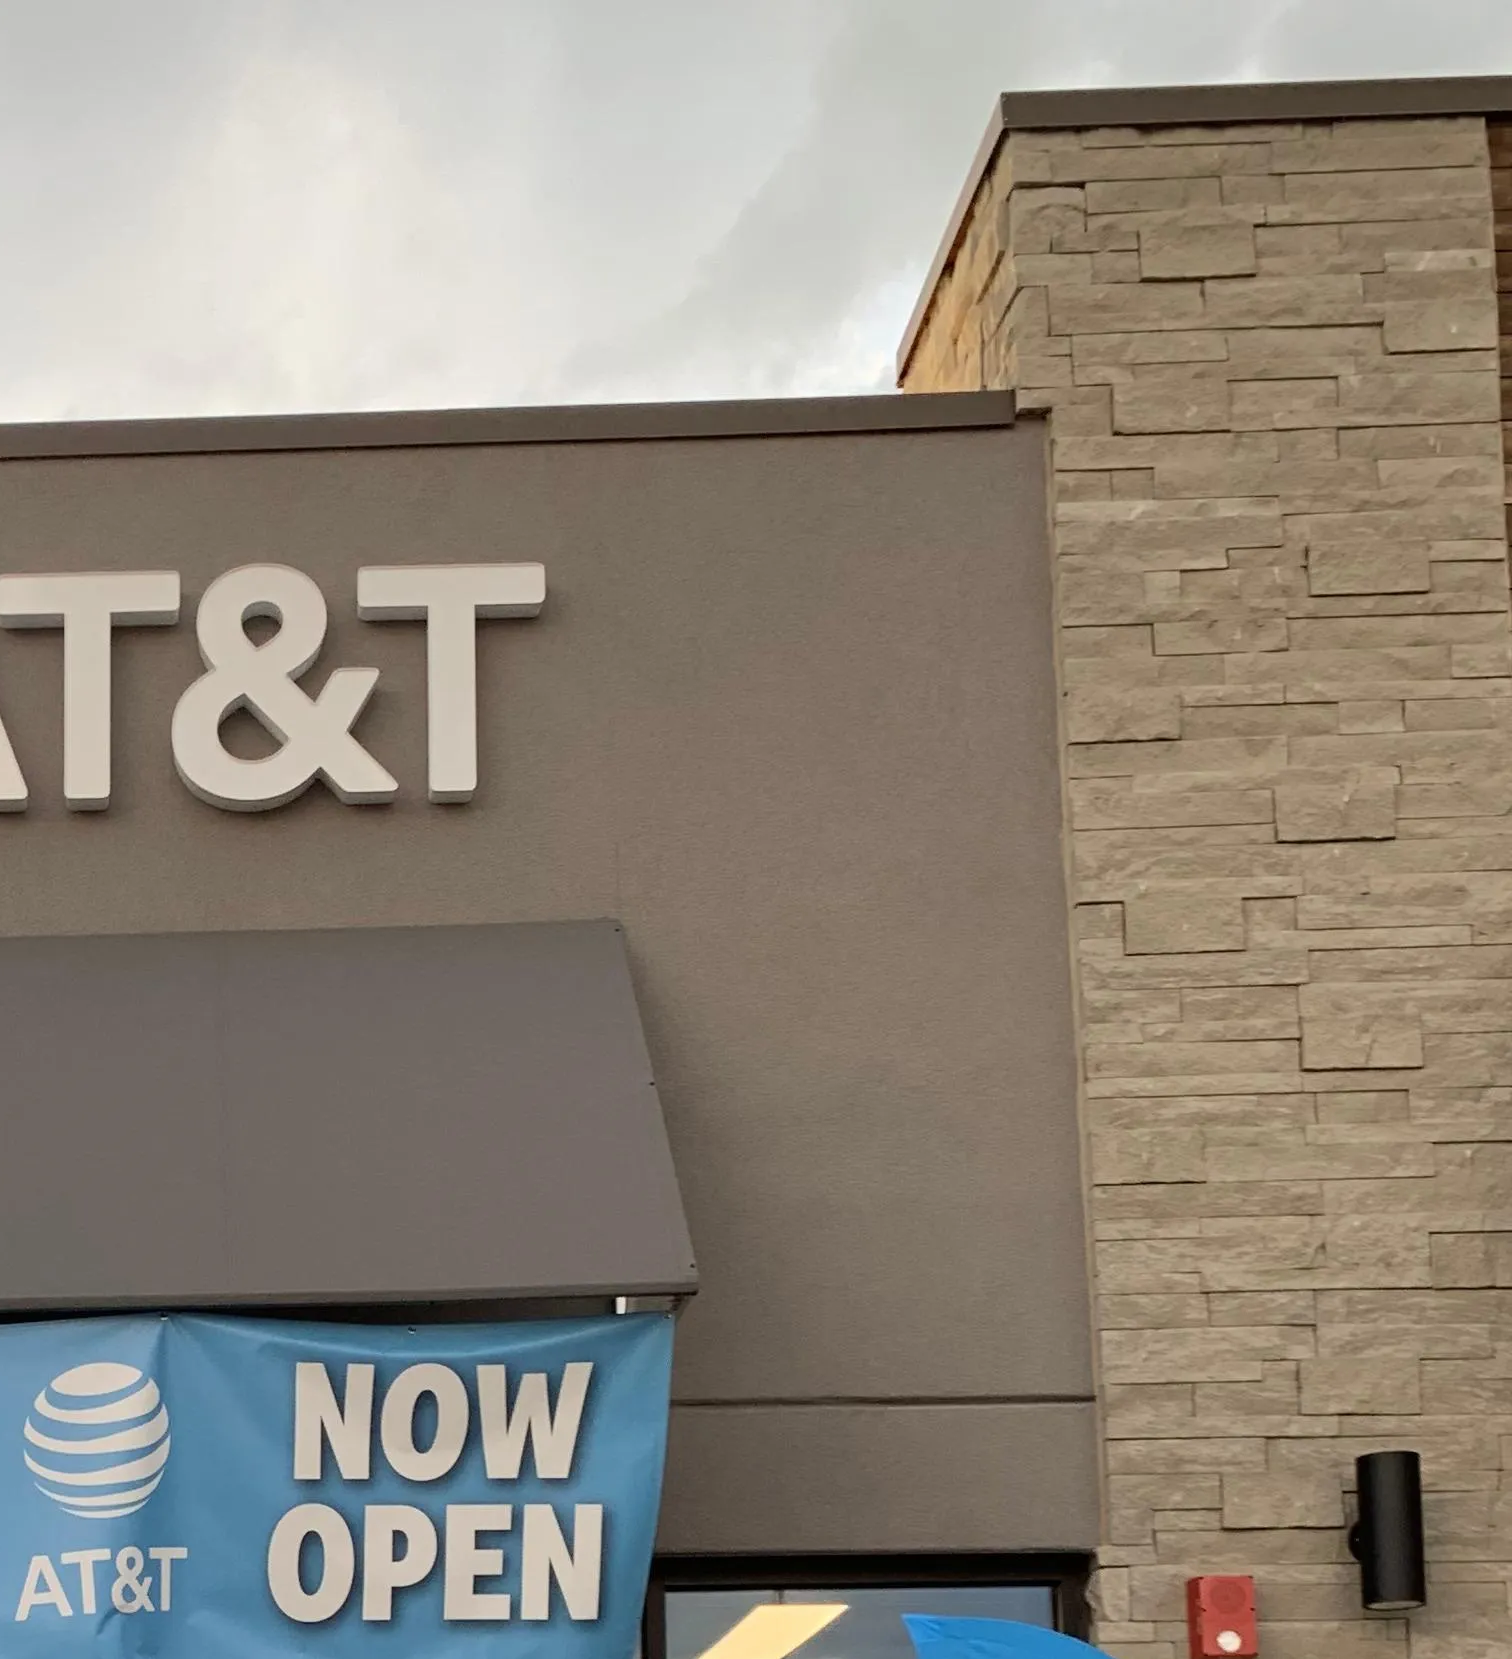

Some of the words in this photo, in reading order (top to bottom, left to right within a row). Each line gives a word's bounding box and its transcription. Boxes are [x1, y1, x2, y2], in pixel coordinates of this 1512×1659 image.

[293, 1361, 594, 1482] NOW
[14, 1546, 188, 1622] AT&T
[267, 1502, 603, 1624] OPEN
